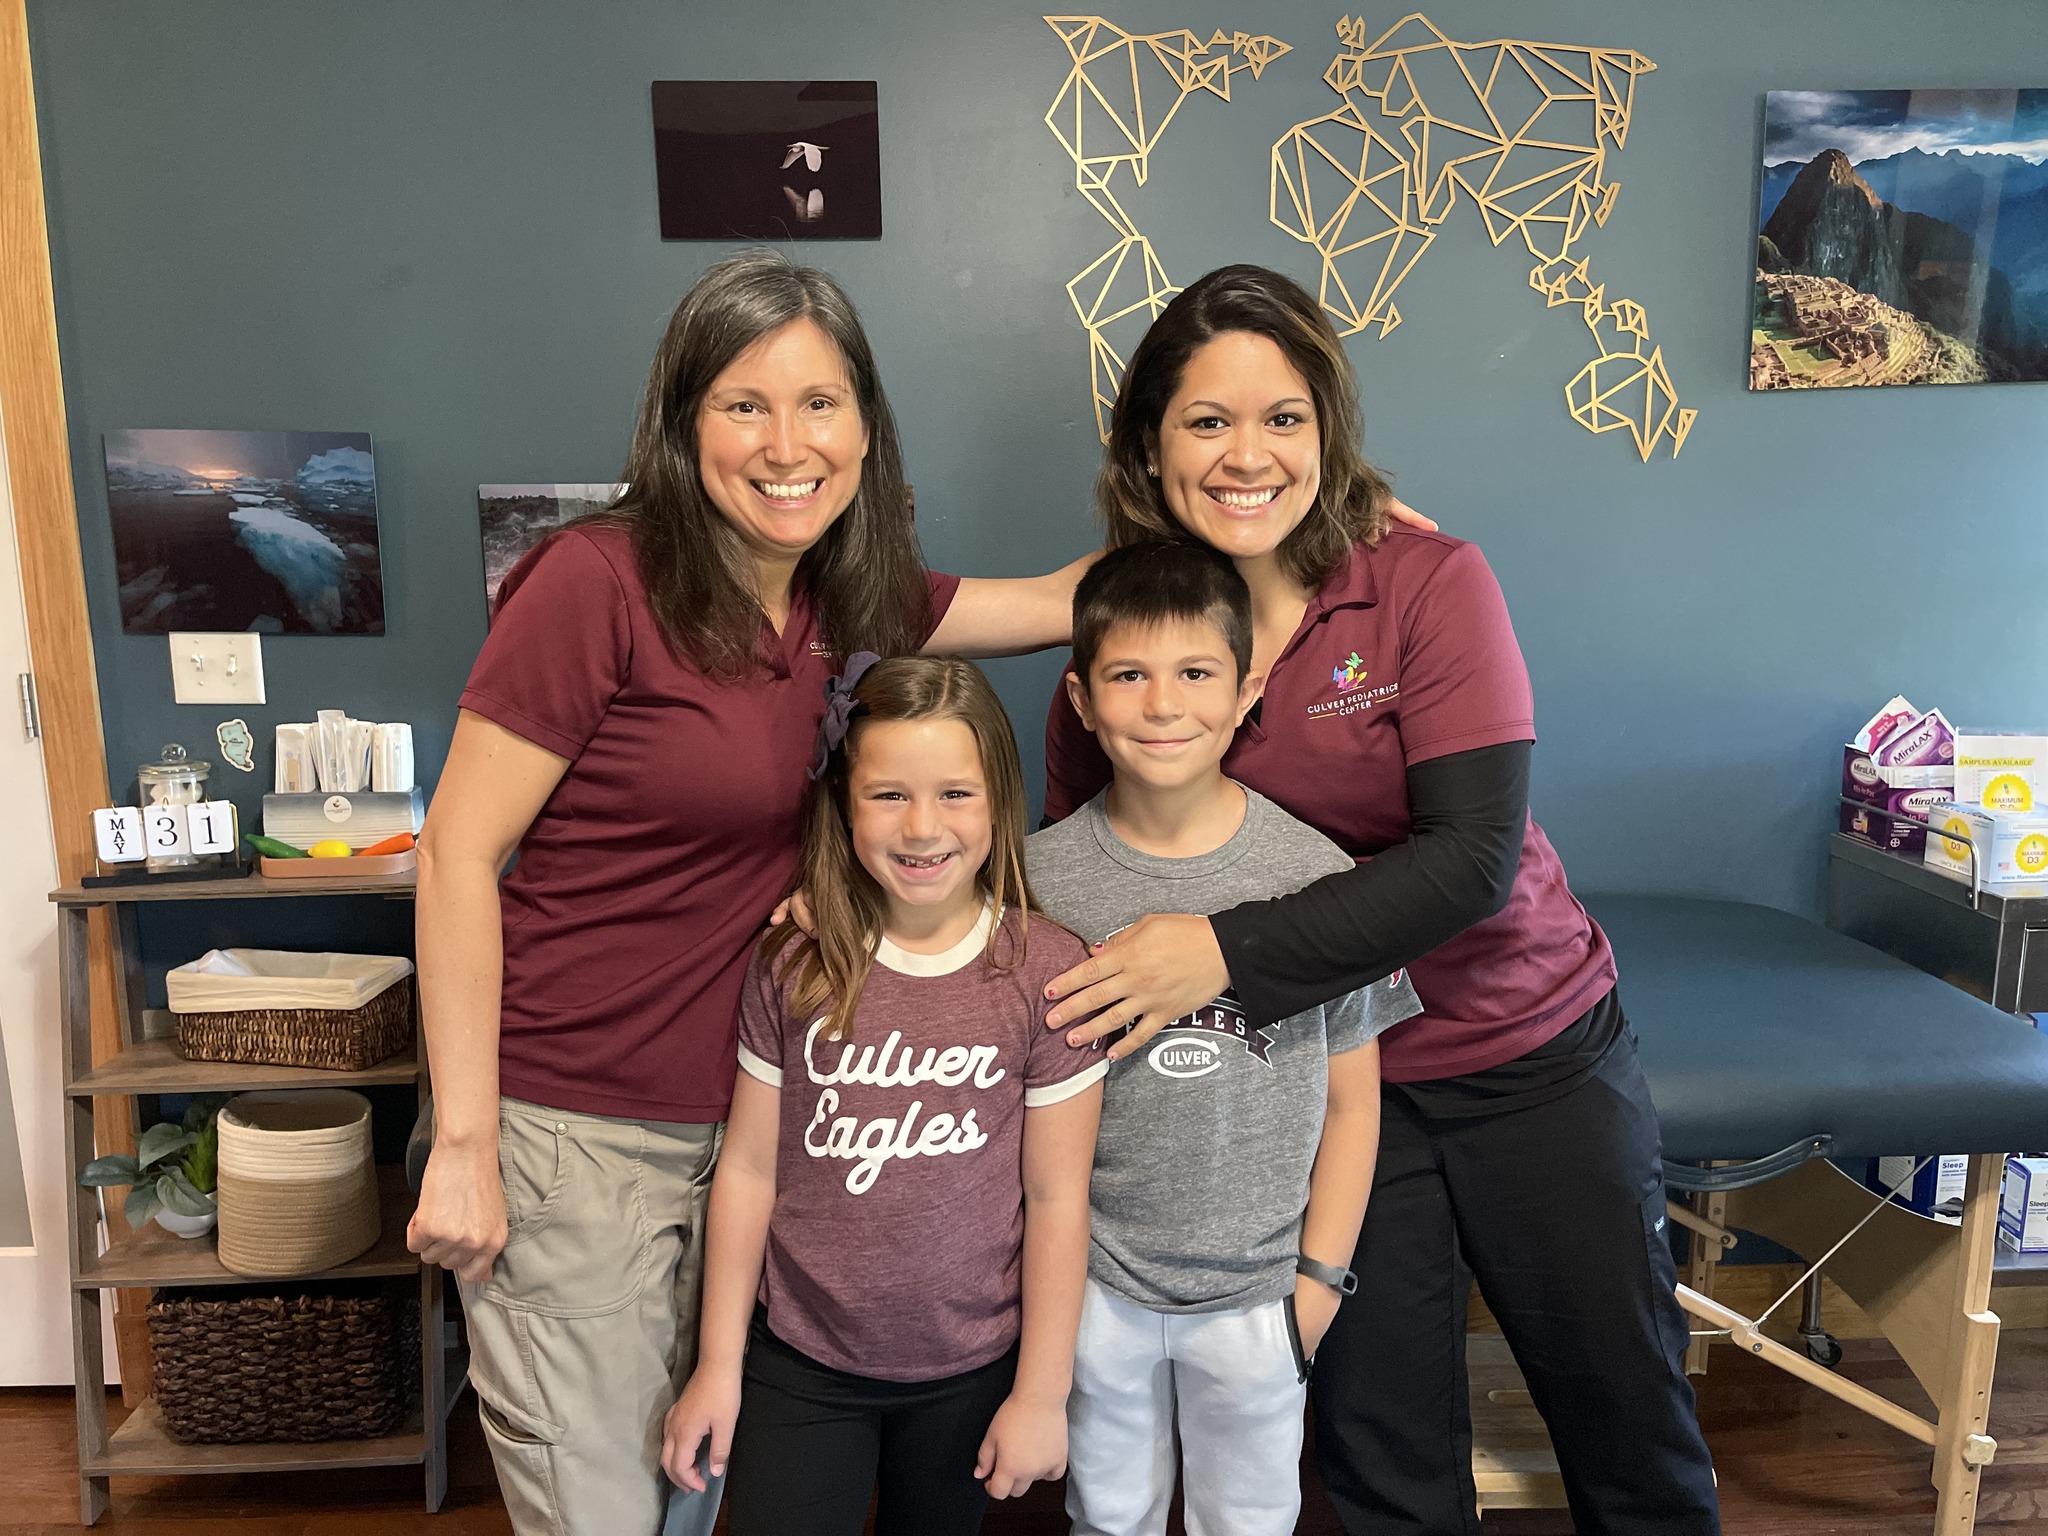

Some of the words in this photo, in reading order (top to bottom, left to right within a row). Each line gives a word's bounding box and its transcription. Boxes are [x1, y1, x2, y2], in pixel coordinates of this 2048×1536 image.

[1307, 700, 1345, 713] CULVER
[1347, 682, 1398, 704] PEDIATRICS
[1339, 701, 1371, 716] CENTER
[1893, 731, 1932, 764] MiraLAX
[1854, 763, 1876, 776] MiraLAX
[109, 817, 126, 855] MAY
[1950, 841, 1961, 851] D3
[2027, 856, 2040, 864] D3
[804, 1015, 1006, 1089] Culver
[804, 1088, 988, 1195] Eagles
